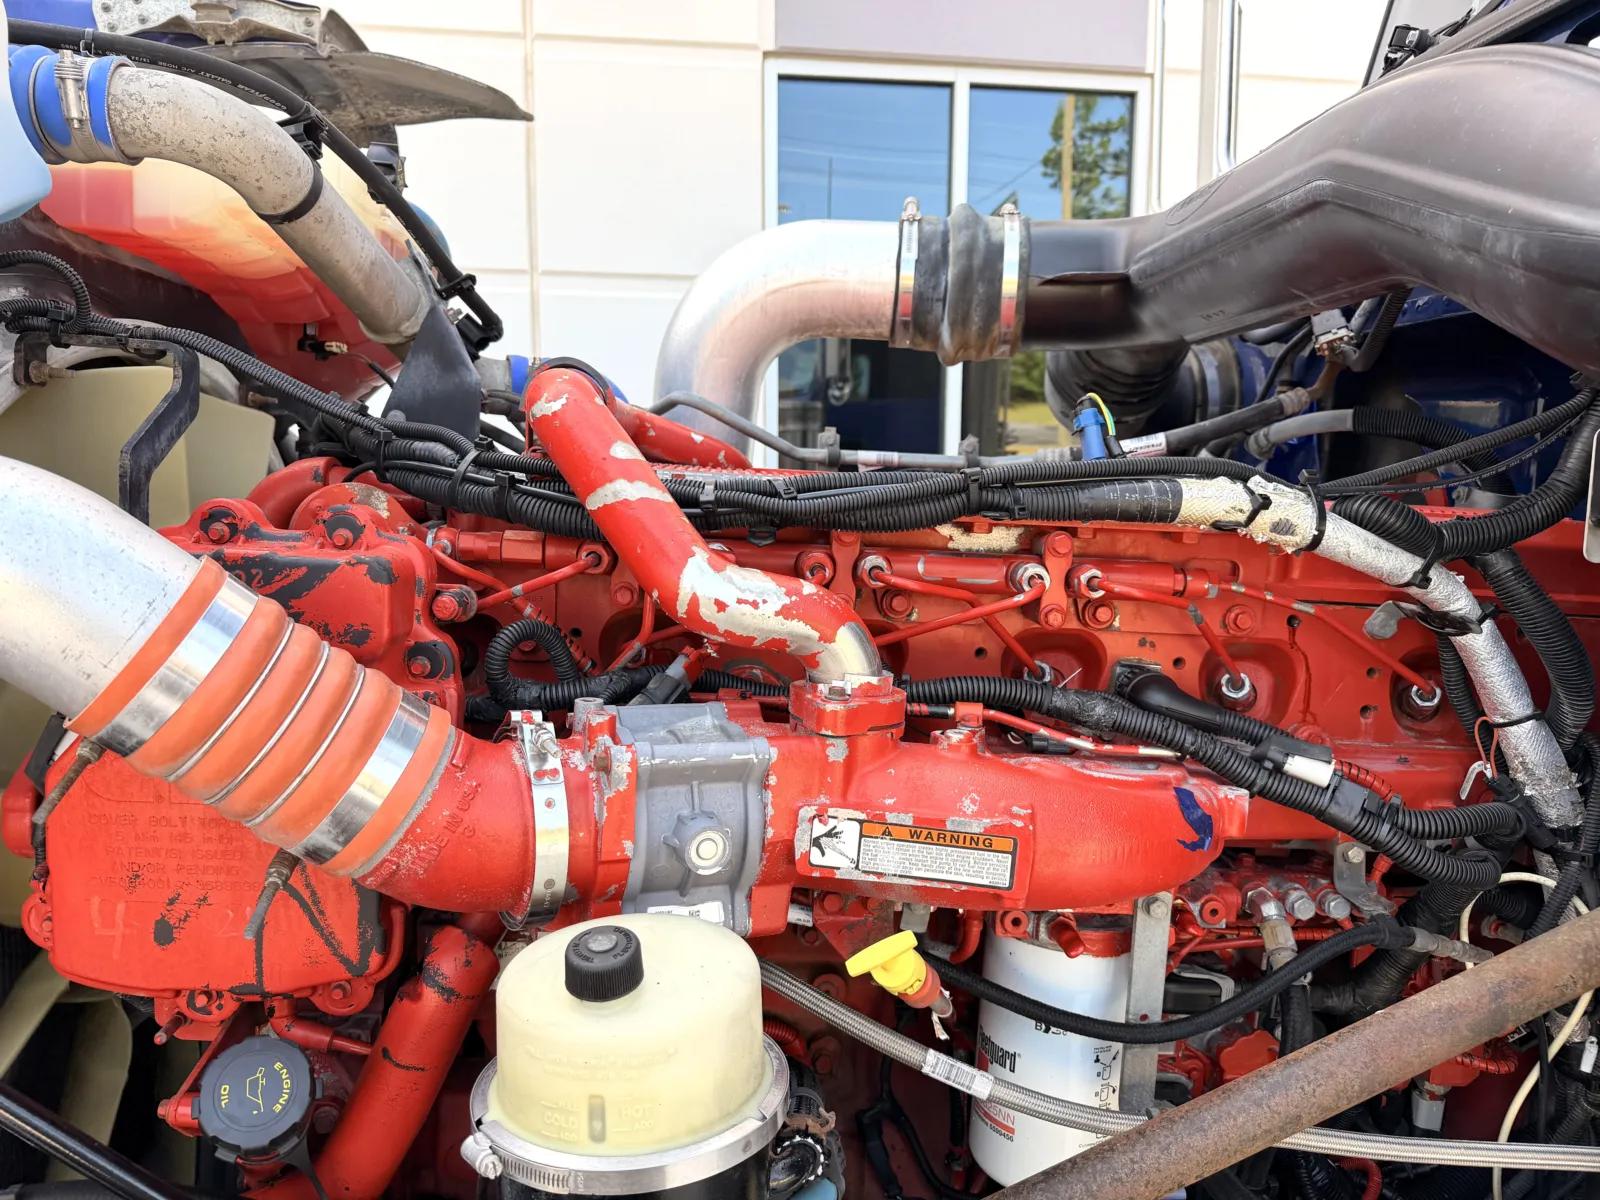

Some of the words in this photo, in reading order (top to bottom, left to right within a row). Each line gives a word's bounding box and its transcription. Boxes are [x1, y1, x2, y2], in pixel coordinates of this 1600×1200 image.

[199, 71, 232, 85] GALAXY
[237, 84, 287, 110] GOODYEAR
[908, 828, 994, 848] WARNING
[220, 1085, 230, 1109] OIL
[273, 1061, 291, 1114] ENGINE
[543, 1111, 578, 1129] COLD
[621, 1103, 651, 1119] HOT
